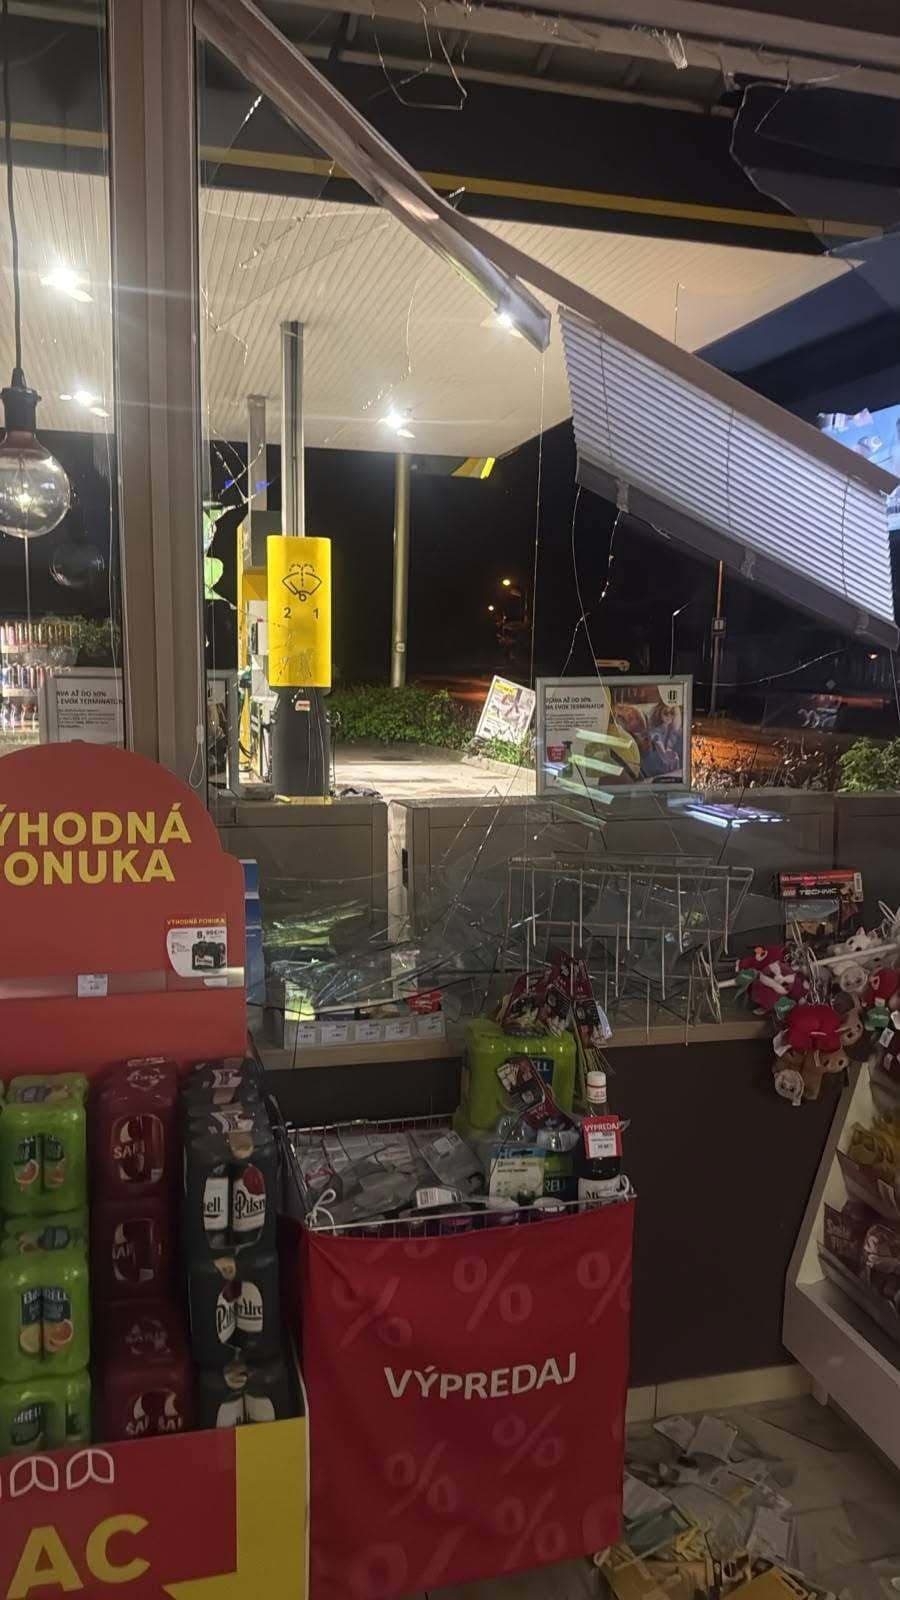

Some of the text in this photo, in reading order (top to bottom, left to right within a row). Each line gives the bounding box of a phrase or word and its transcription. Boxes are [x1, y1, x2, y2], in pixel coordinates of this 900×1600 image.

[284, 607, 319, 619] 2 1
[799, 888, 838, 896] TECHNIC
[384, 1352, 577, 1400] VÝPREDAJ
[5, 1513, 151, 1600] AC
